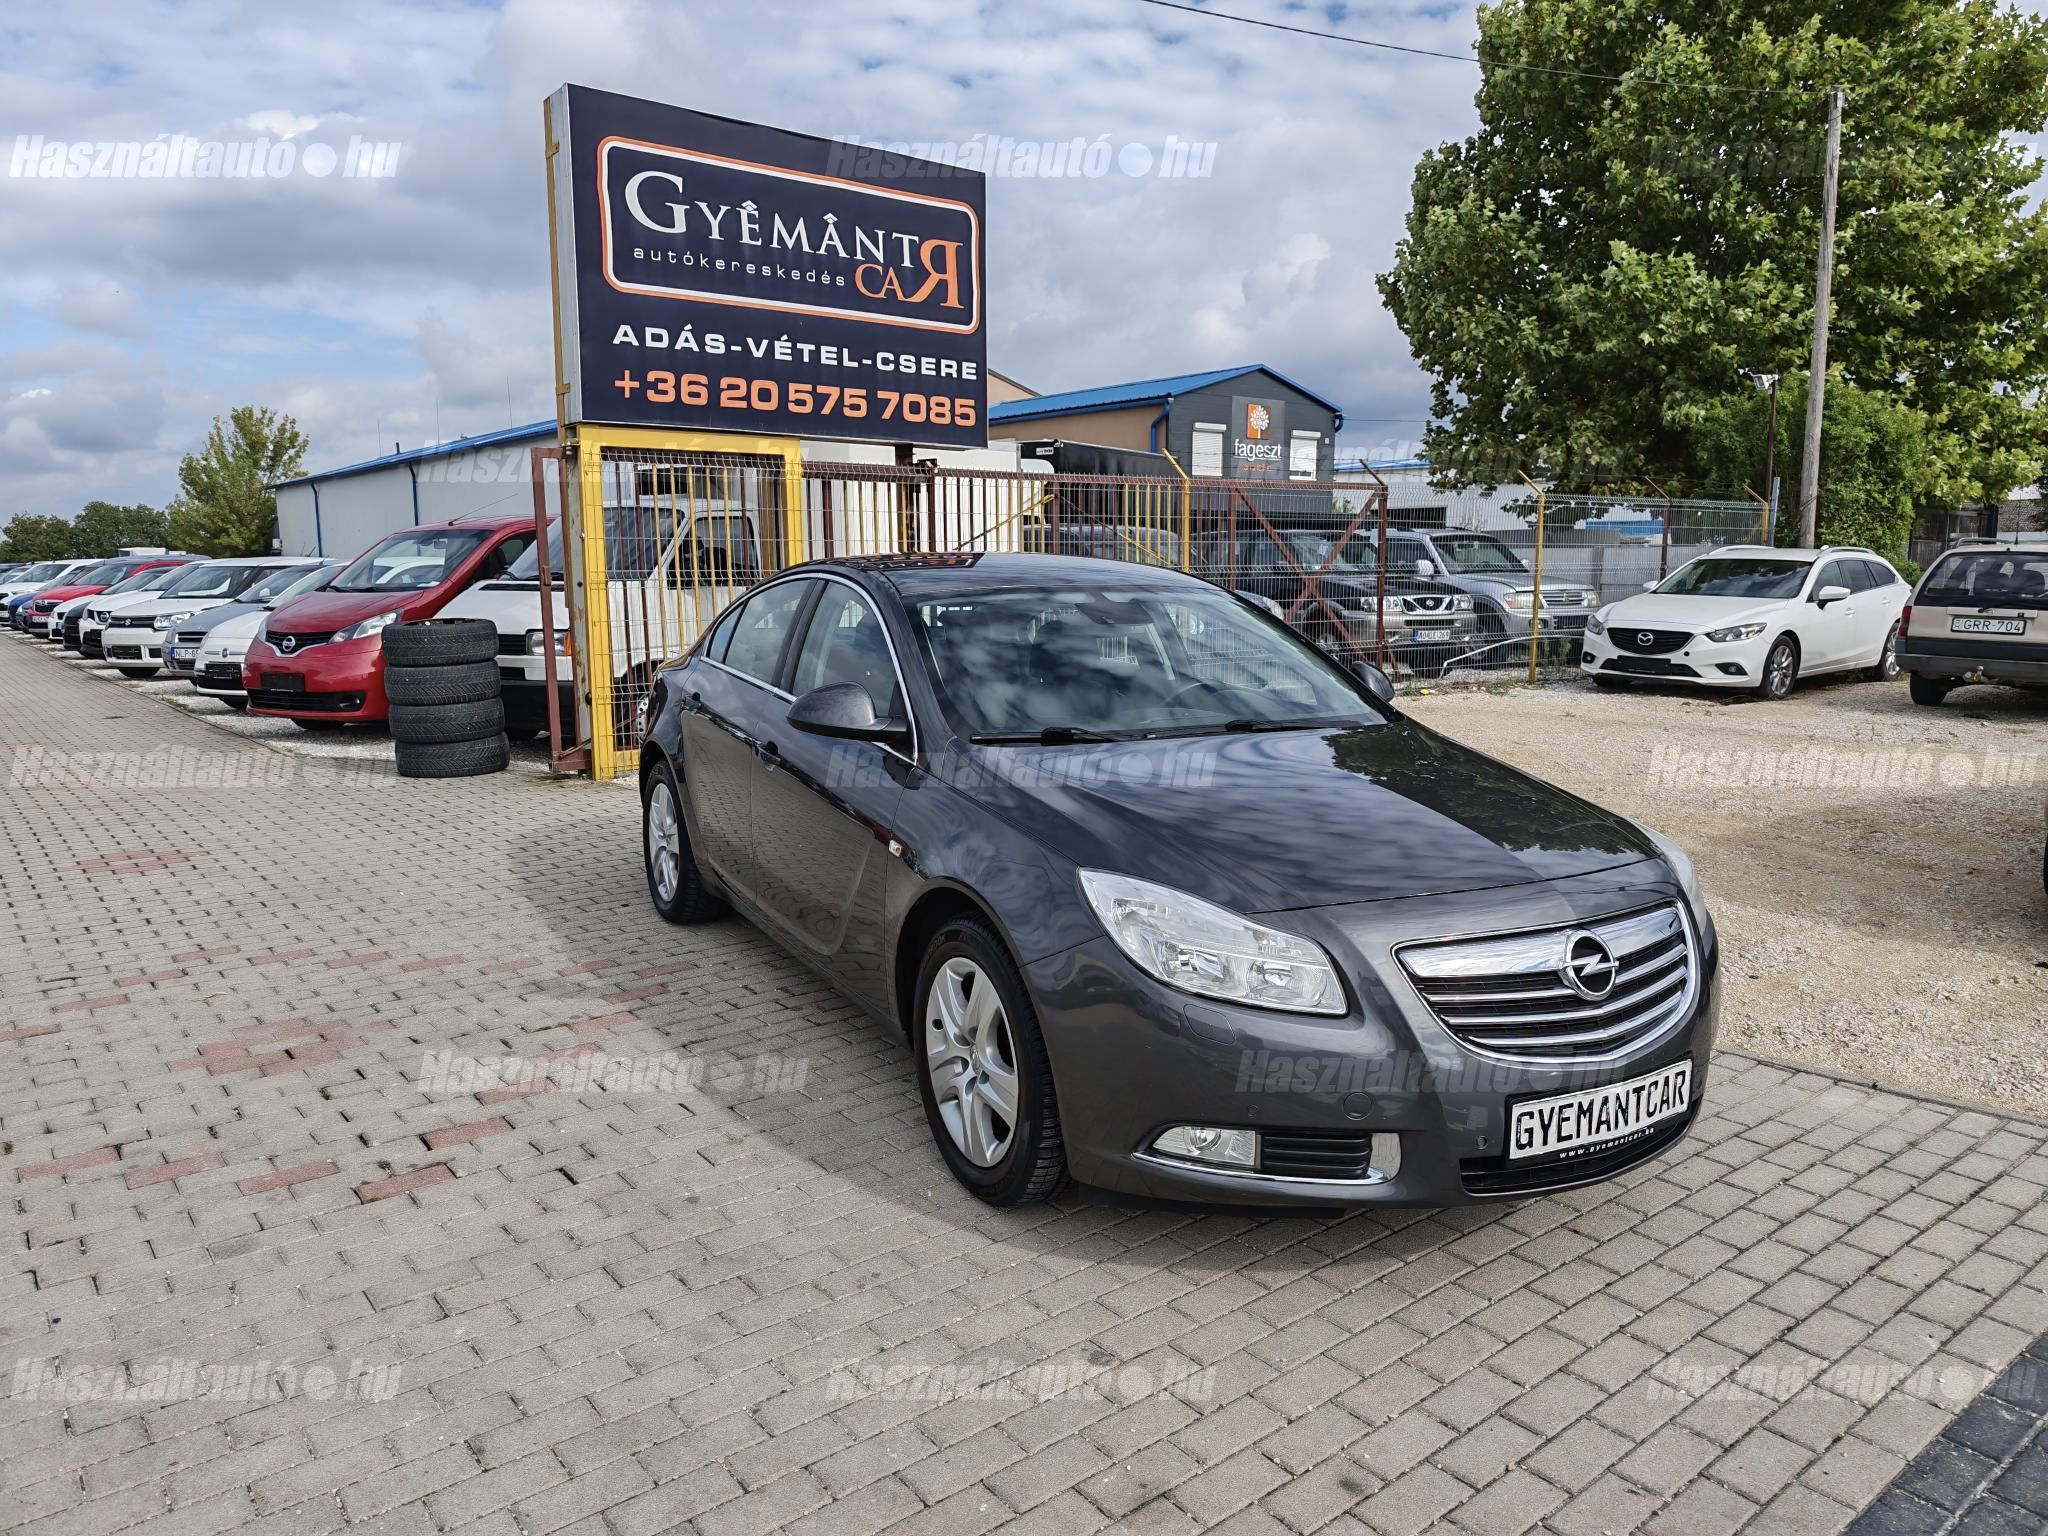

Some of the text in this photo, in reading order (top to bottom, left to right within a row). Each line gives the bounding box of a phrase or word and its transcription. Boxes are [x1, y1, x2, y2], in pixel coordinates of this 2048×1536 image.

[633, 245, 846, 288] autókereskedés
[614, 369, 977, 427] +36 20 575 7085
[1234, 438, 1282, 461] fageszt
[1515, 1069, 1687, 1151] GYEMANTCAR
